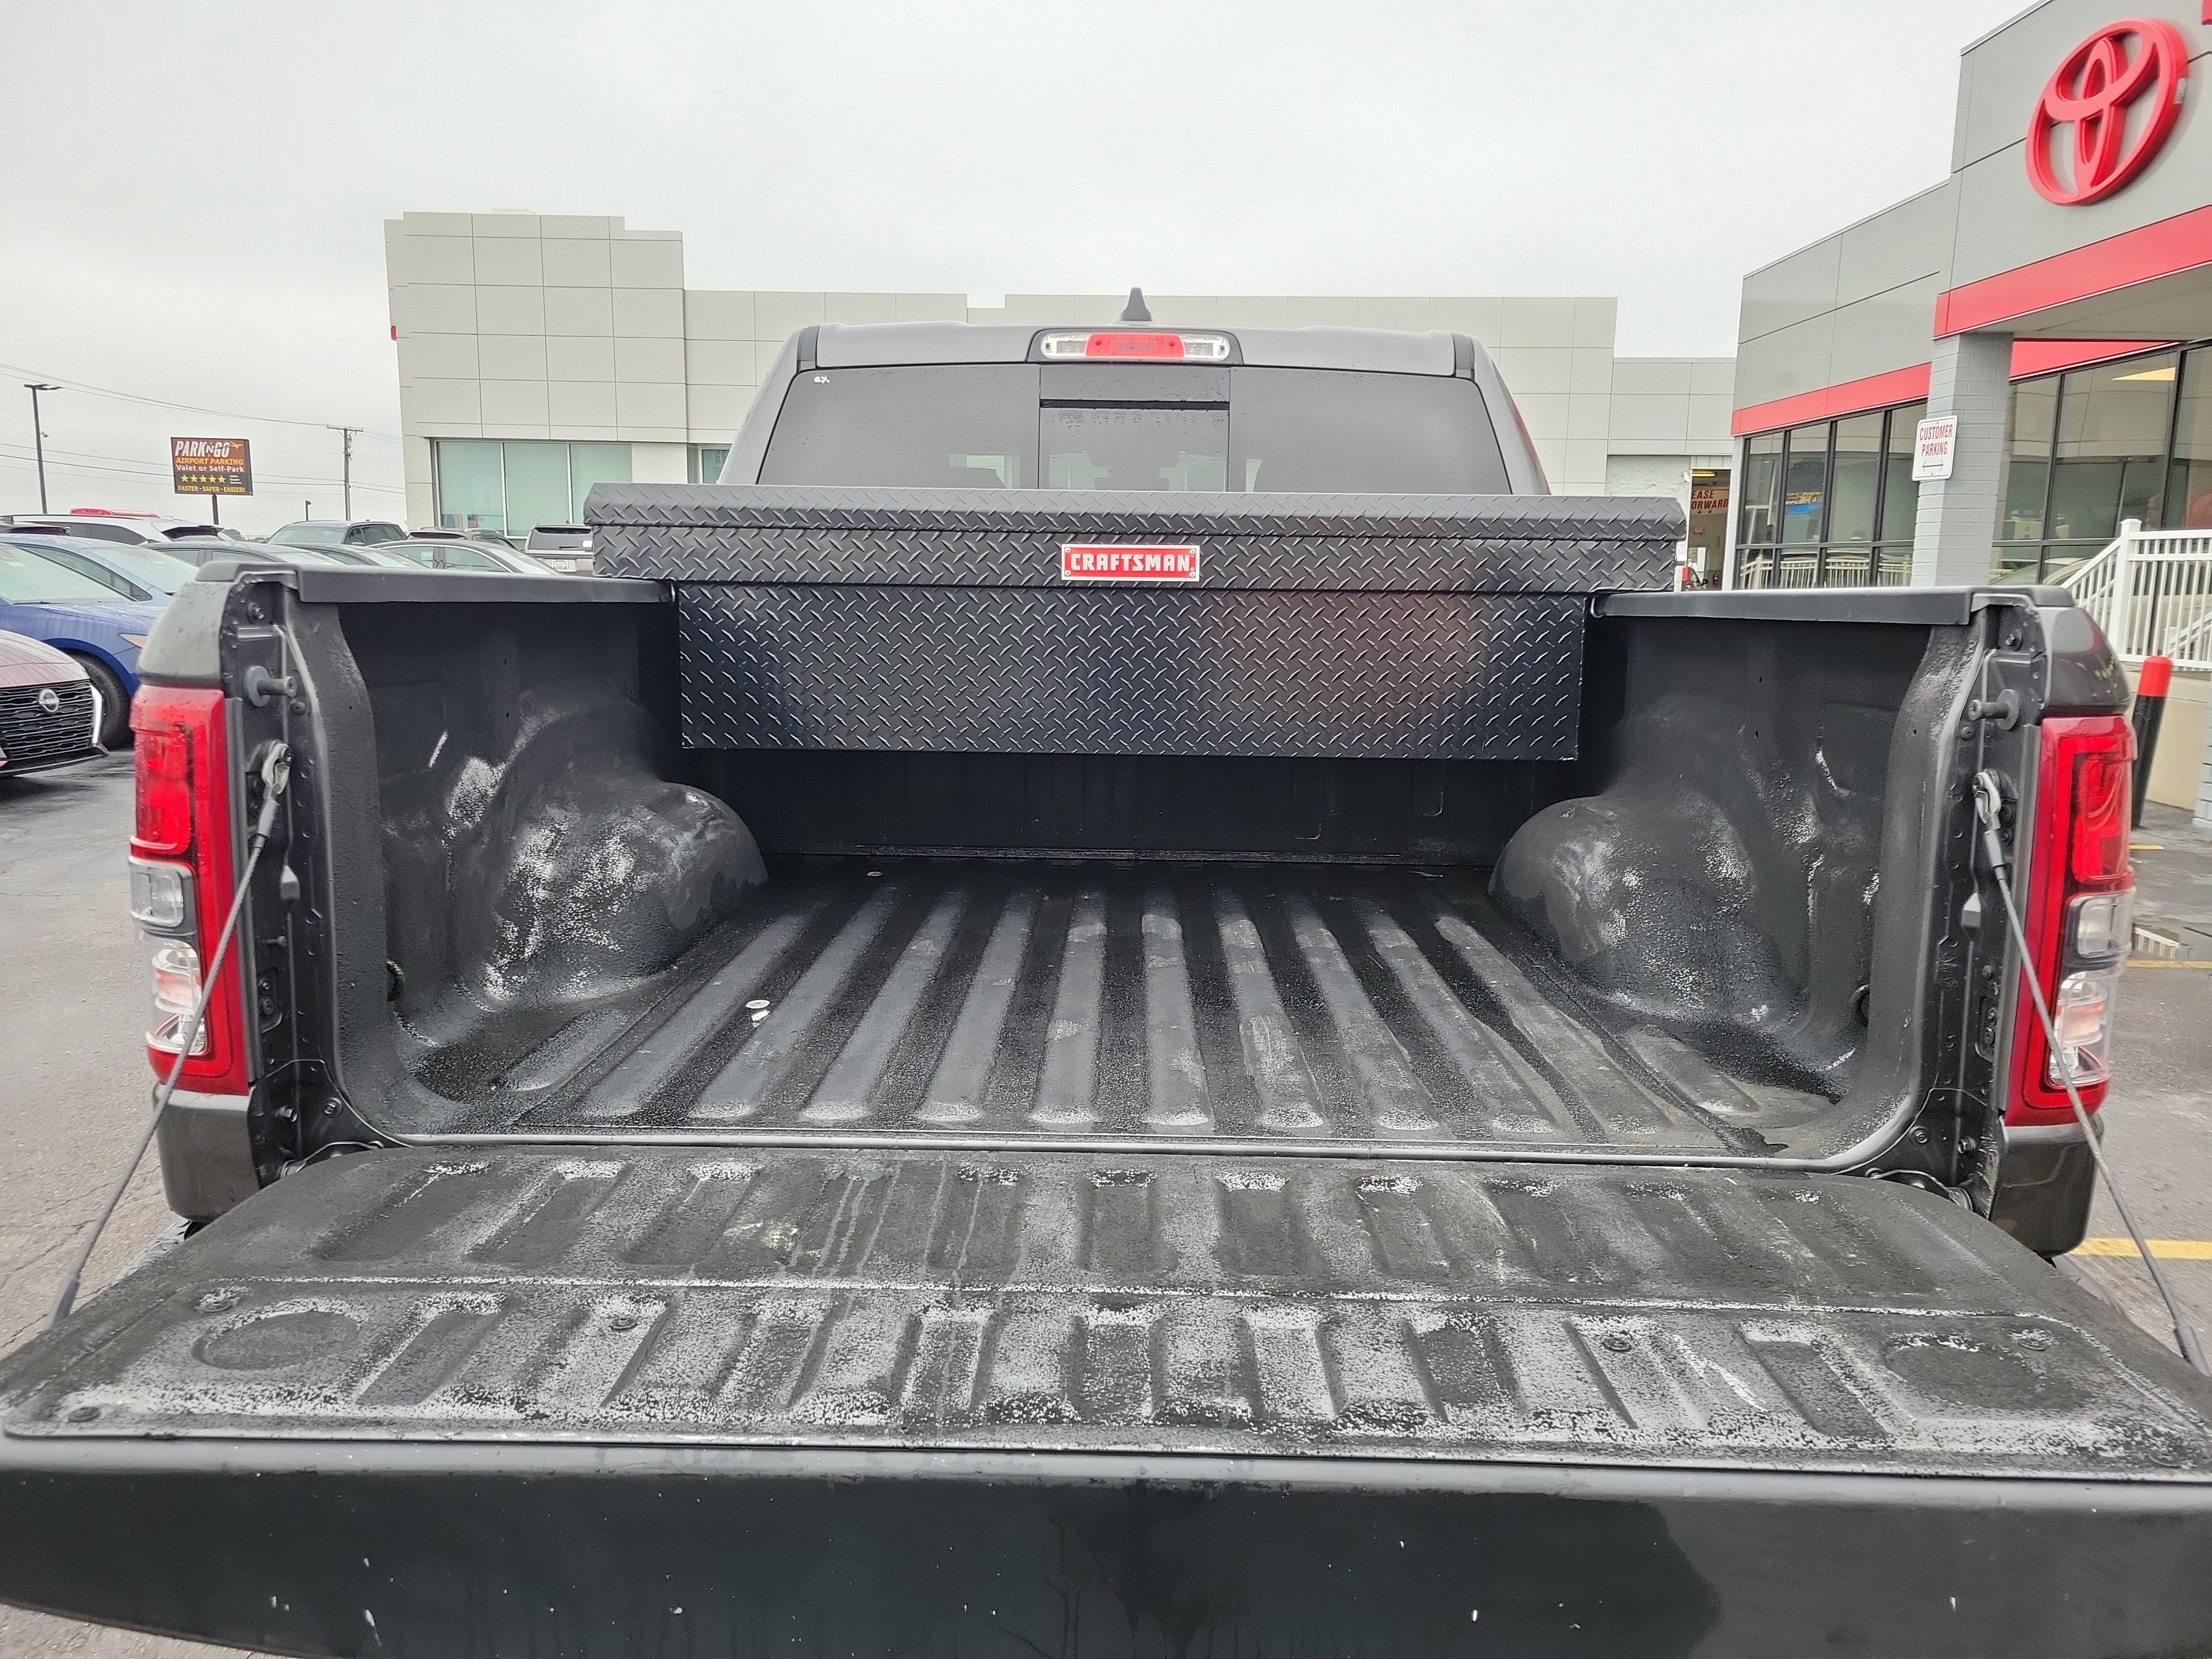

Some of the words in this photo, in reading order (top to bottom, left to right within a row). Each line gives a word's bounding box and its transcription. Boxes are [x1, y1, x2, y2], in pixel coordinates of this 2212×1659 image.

[1920, 424, 1953, 441] CUSTOMER
[1921, 441, 1948, 457] PARKING
[1071, 553, 1189, 572] CRAFTSMAN
